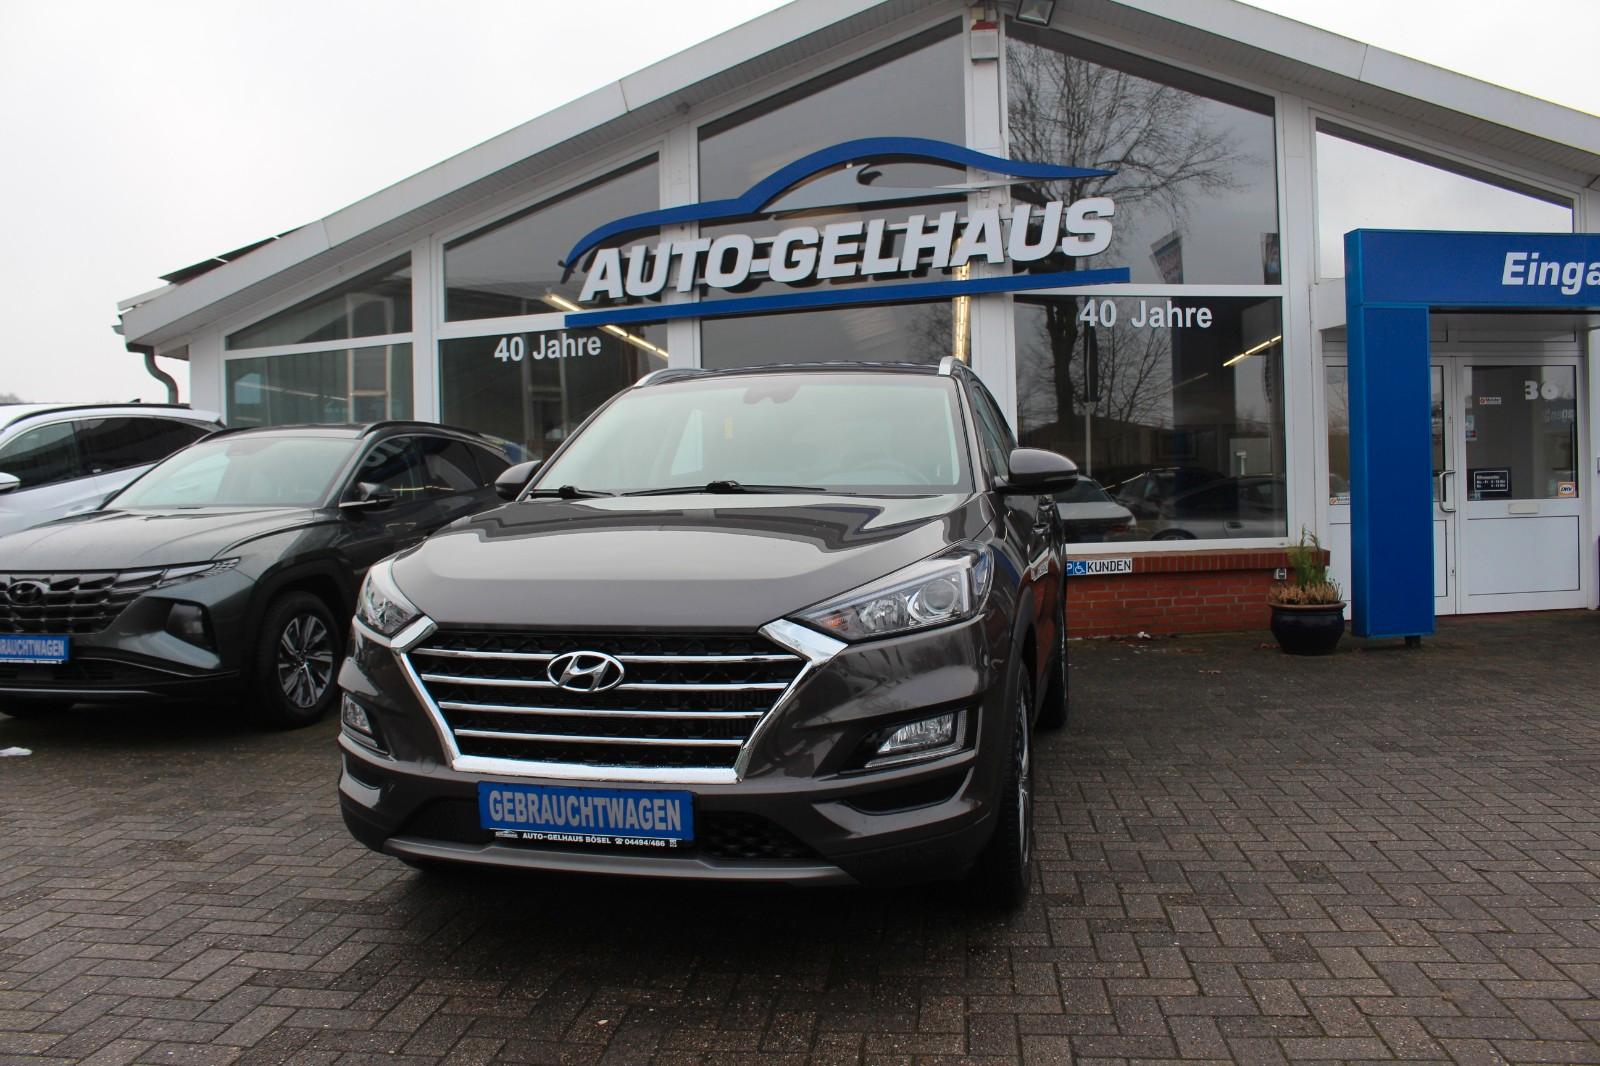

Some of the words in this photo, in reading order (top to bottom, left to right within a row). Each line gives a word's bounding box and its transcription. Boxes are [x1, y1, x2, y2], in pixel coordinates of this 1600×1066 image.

[577, 197, 1115, 301] AUTO-GELHAUS
[1502, 252, 1600, 295] Einga
[1079, 299, 1117, 328] 40
[1131, 300, 1213, 328] Jahre
[494, 336, 524, 362] 40
[532, 332, 602, 360] Jahre
[1087, 560, 1131, 573] KUNDEN
[489, 790, 681, 832] GEBRAUCHTWAGEN
[522, 832, 584, 842] AUTO-GELHAUS
[585, 835, 611, 844] BÖSEL
